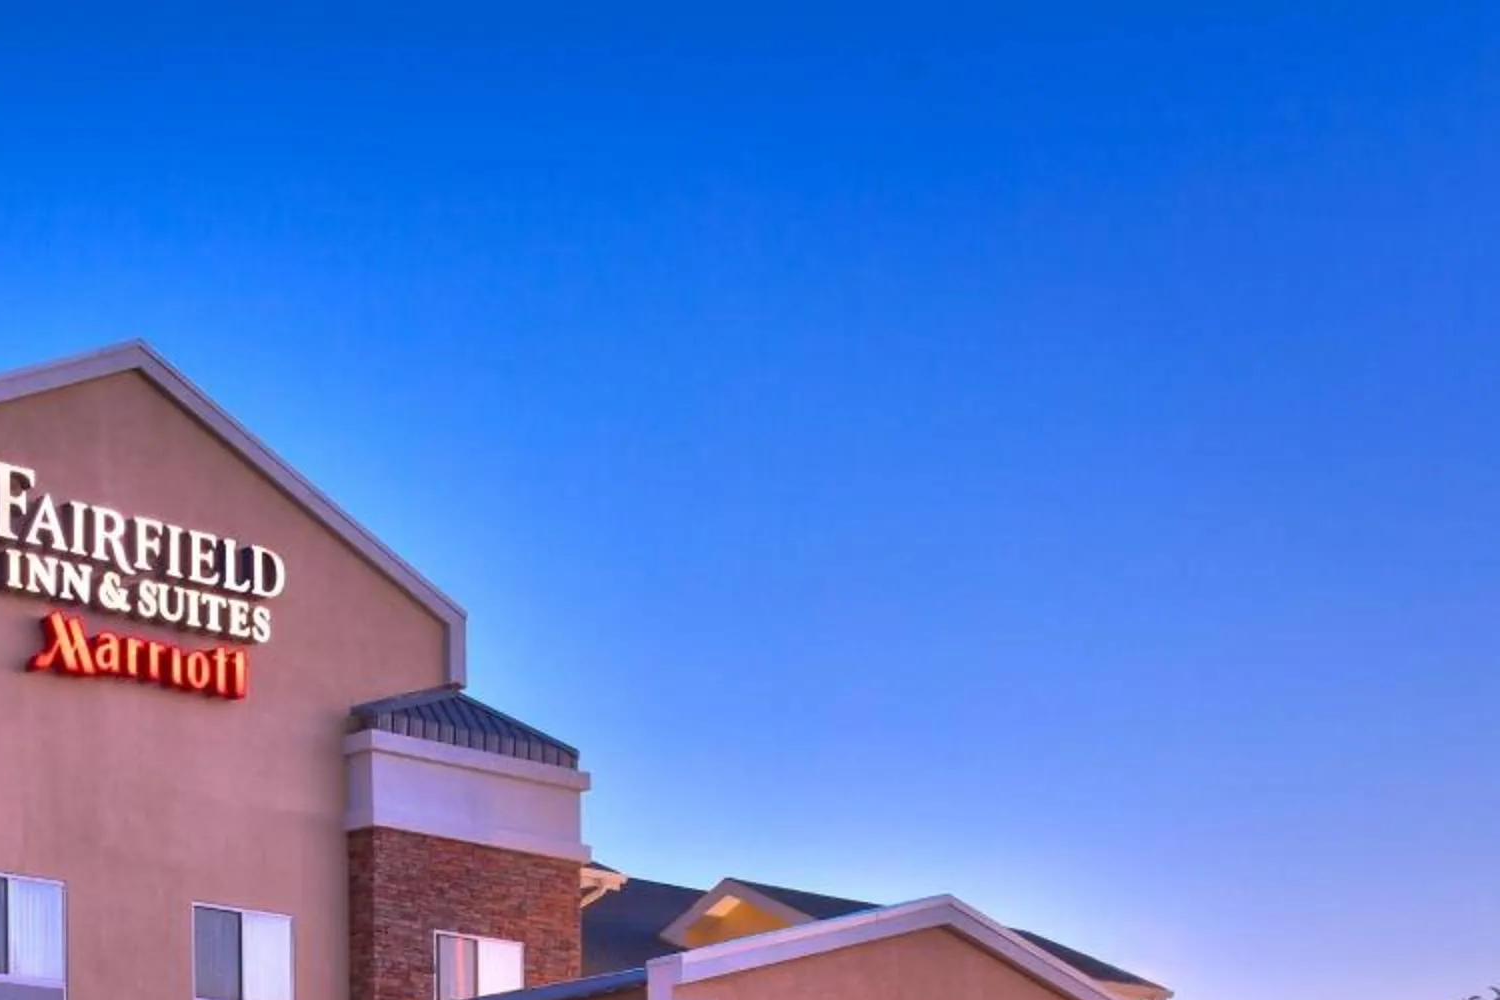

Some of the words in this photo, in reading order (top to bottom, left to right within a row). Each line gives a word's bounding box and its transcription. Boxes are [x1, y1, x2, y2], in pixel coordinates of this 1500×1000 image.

[5, 549, 93, 605] INN
[98, 571, 131, 613] &
[137, 579, 272, 644] SUITES
[26, 608, 249, 700] Marriott
